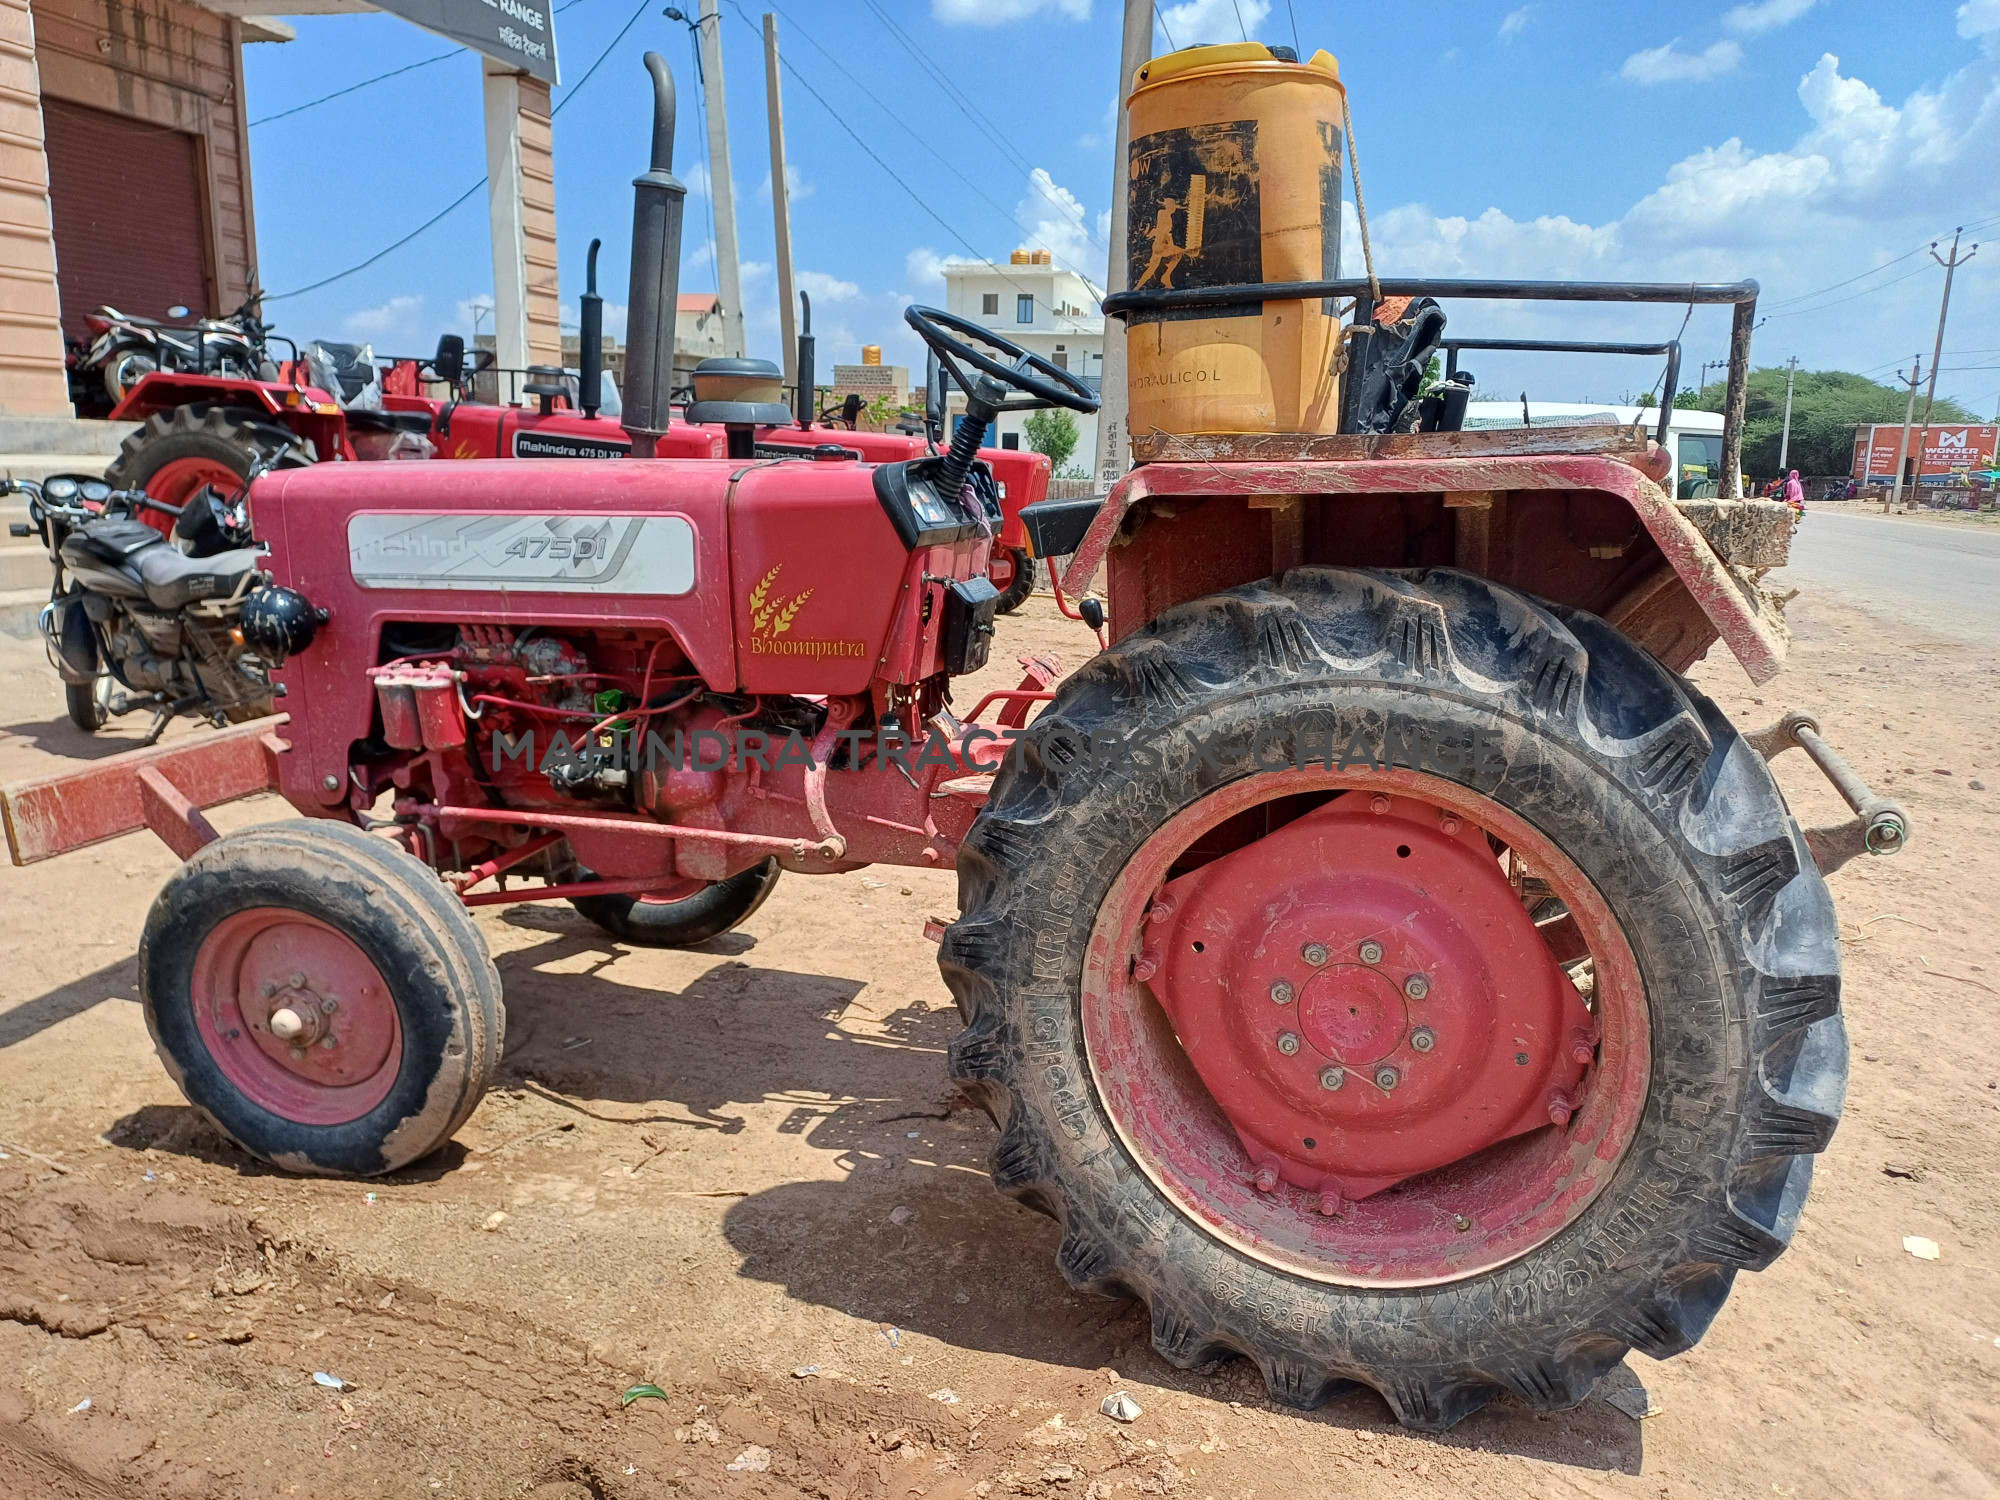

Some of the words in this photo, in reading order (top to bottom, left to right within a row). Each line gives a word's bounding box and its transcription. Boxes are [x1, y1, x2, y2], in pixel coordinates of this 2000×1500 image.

[500, 0, 544, 31] RANGE
[1130, 370, 1192, 390] YDRAULIC
[579, 447, 595, 458] 475
[750, 636, 866, 662] Bhoomiputra
